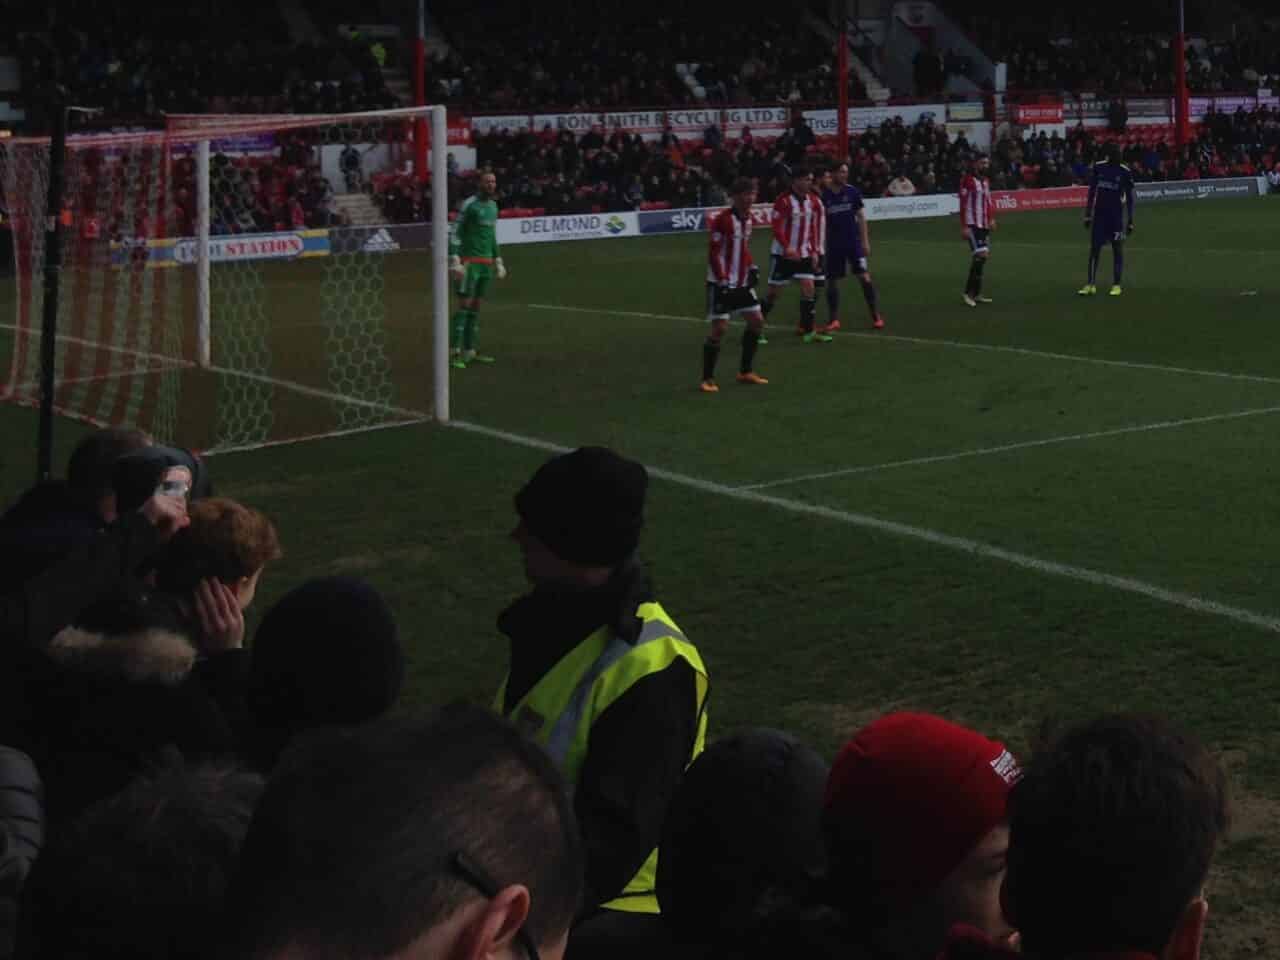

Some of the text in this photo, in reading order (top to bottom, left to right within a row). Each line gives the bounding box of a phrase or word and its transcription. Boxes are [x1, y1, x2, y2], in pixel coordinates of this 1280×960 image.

[558, 114, 592, 131] RON
[596, 113, 649, 129] SMITH
[746, 108, 774, 123] LTD
[520, 216, 602, 235] DELMOND
[671, 208, 703, 231] sky
